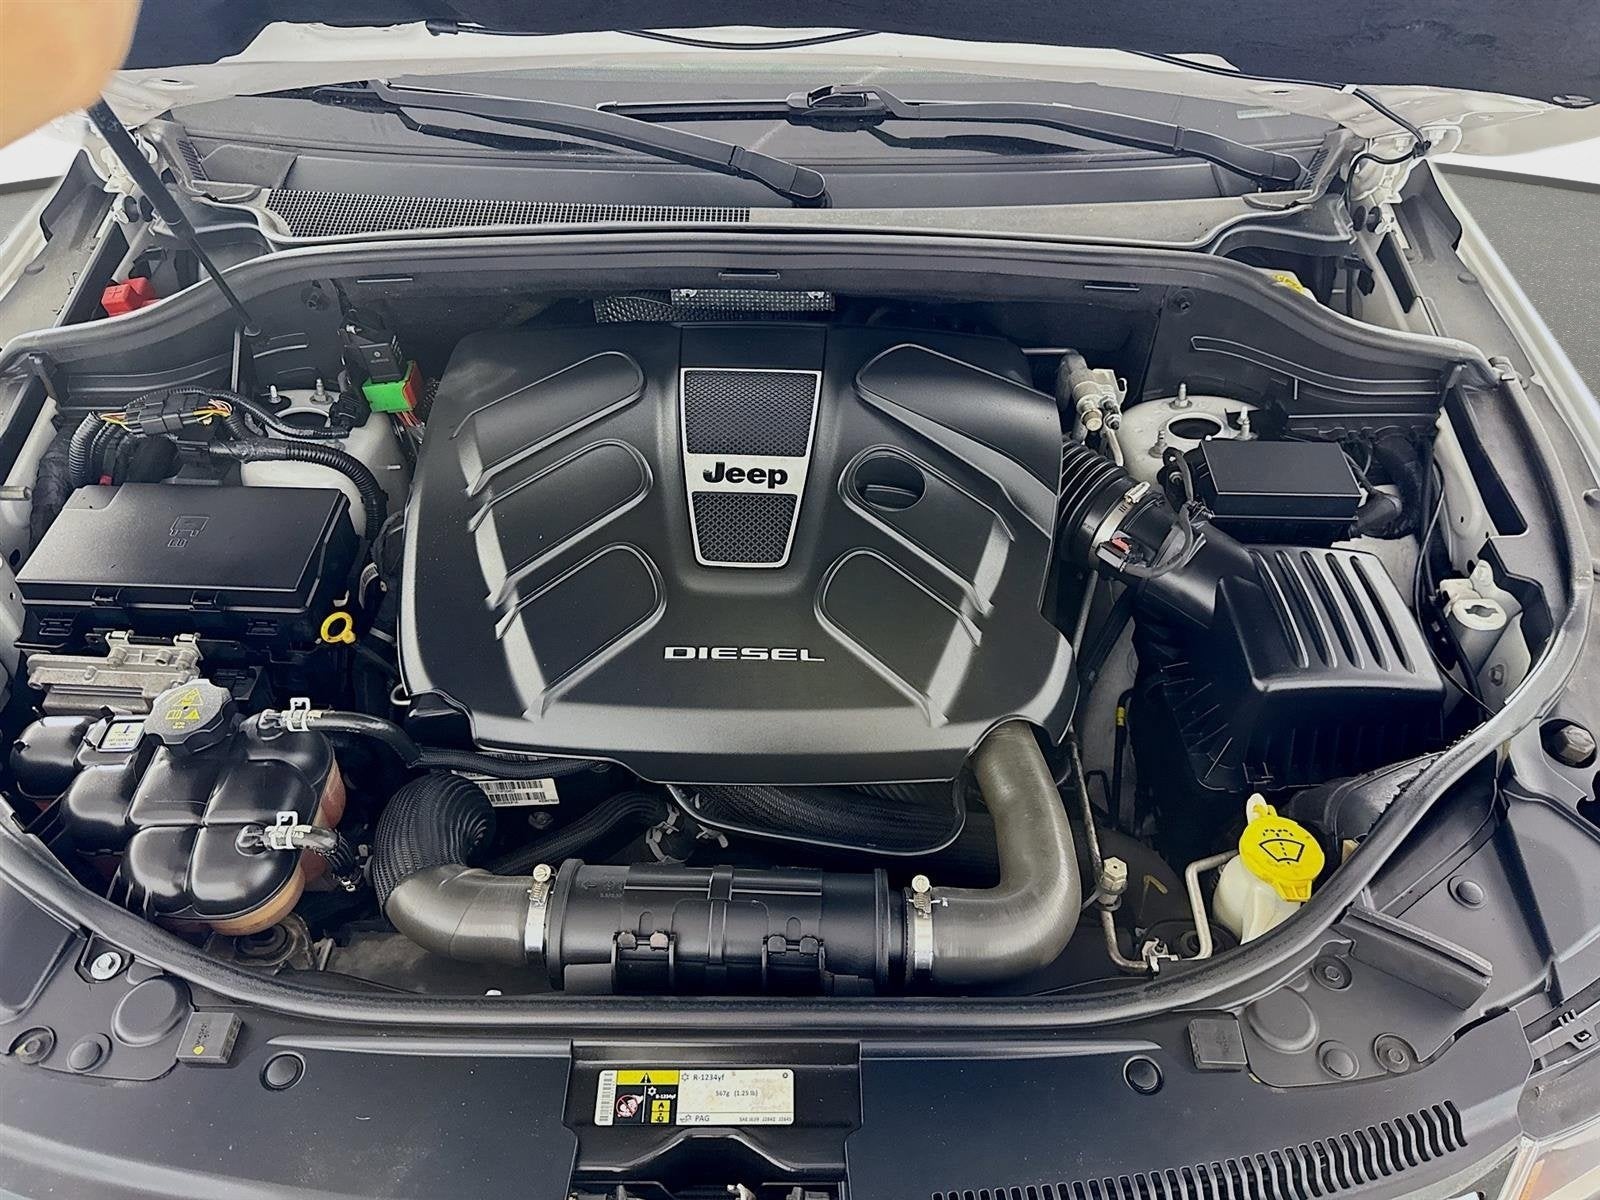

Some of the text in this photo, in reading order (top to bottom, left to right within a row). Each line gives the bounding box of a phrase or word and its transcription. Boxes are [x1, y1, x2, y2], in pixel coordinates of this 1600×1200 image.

[703, 462, 788, 489] Jeep
[664, 646, 825, 662] DIESEL
[693, 1073, 725, 1082] R-1234yf
